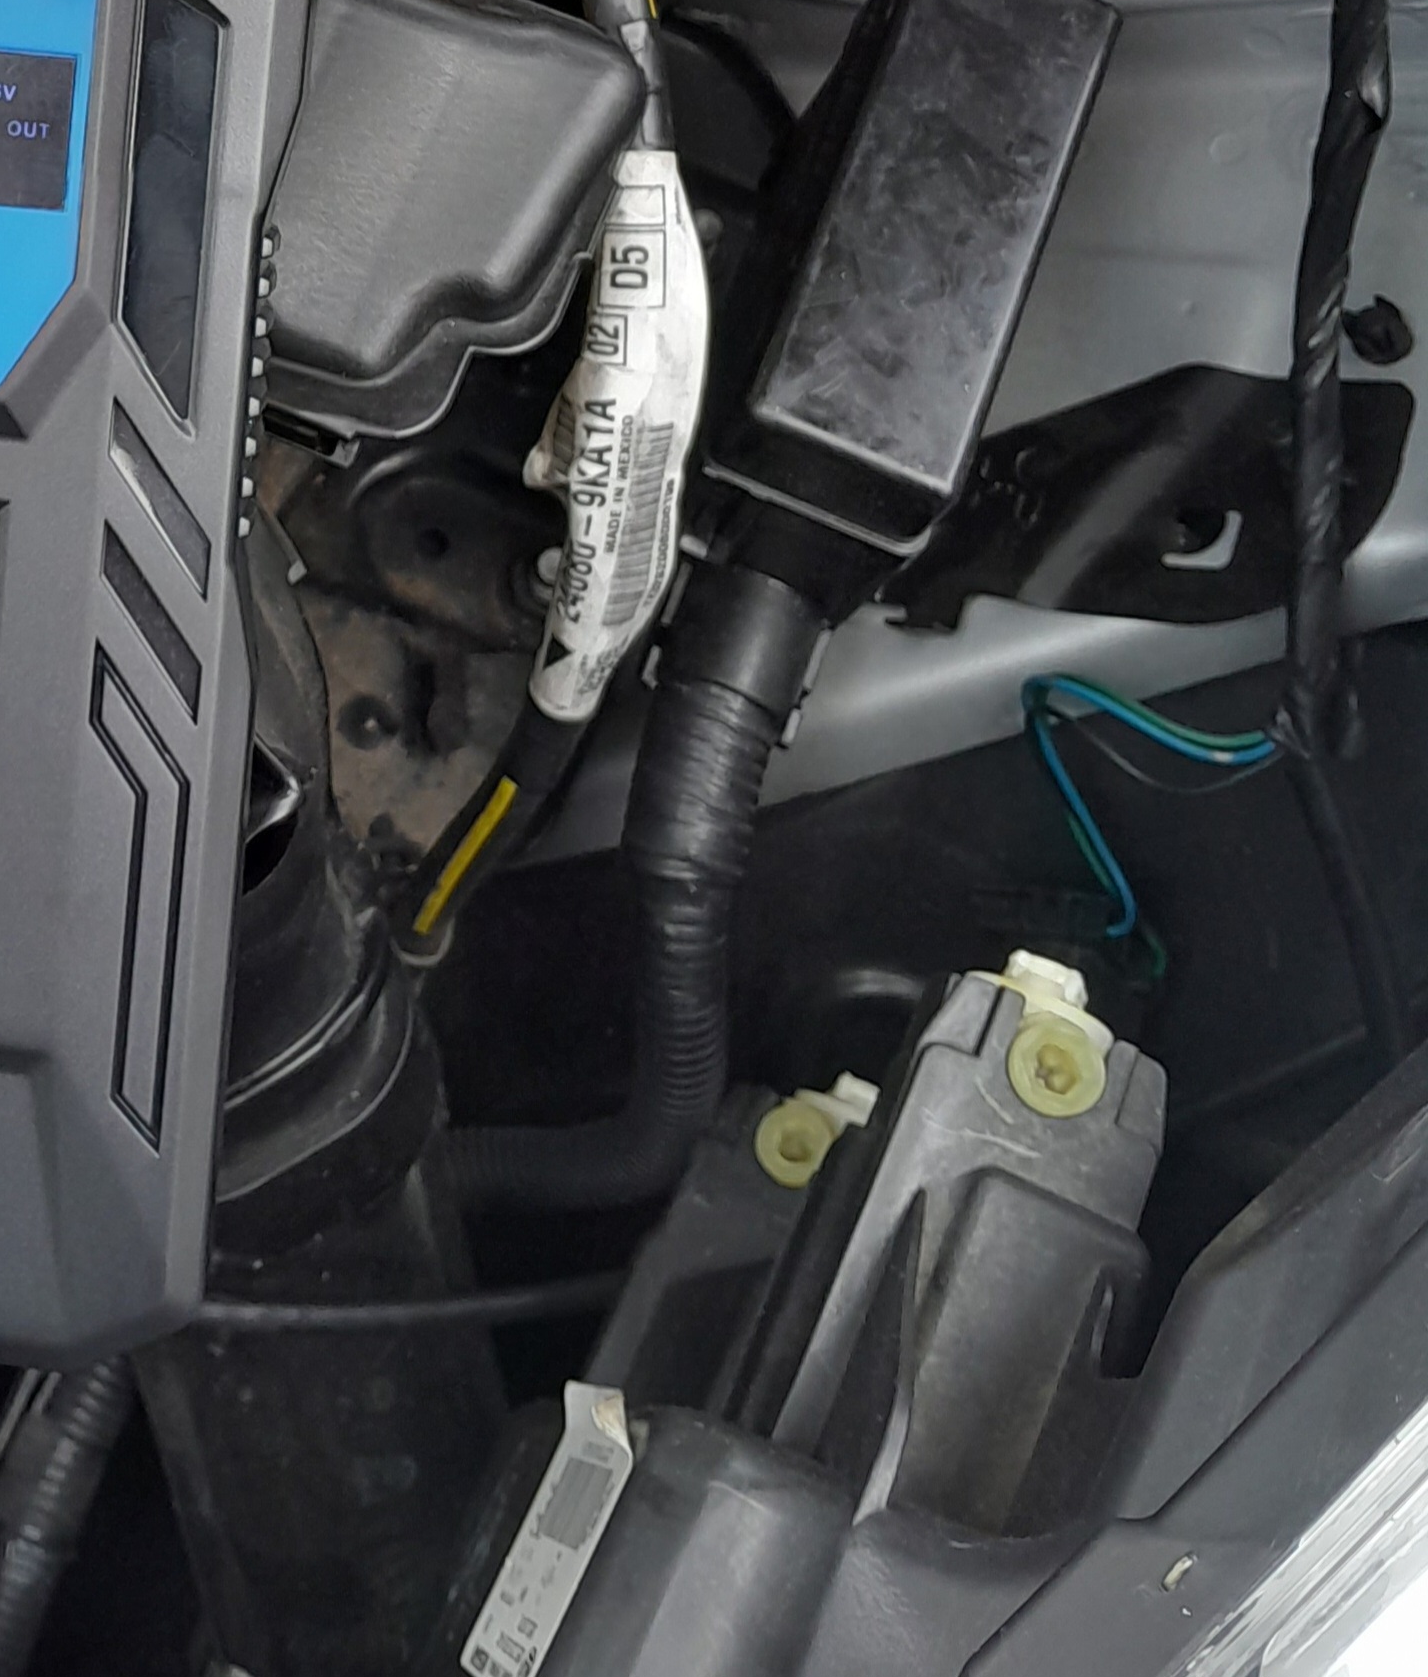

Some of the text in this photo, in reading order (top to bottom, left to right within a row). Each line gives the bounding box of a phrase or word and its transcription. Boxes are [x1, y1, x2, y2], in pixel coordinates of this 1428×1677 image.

[7, 120, 50, 139] OUT
[610, 245, 649, 291] D5
[590, 324, 620, 356] 02
[602, 415, 634, 553] MADE IN MEXICO
